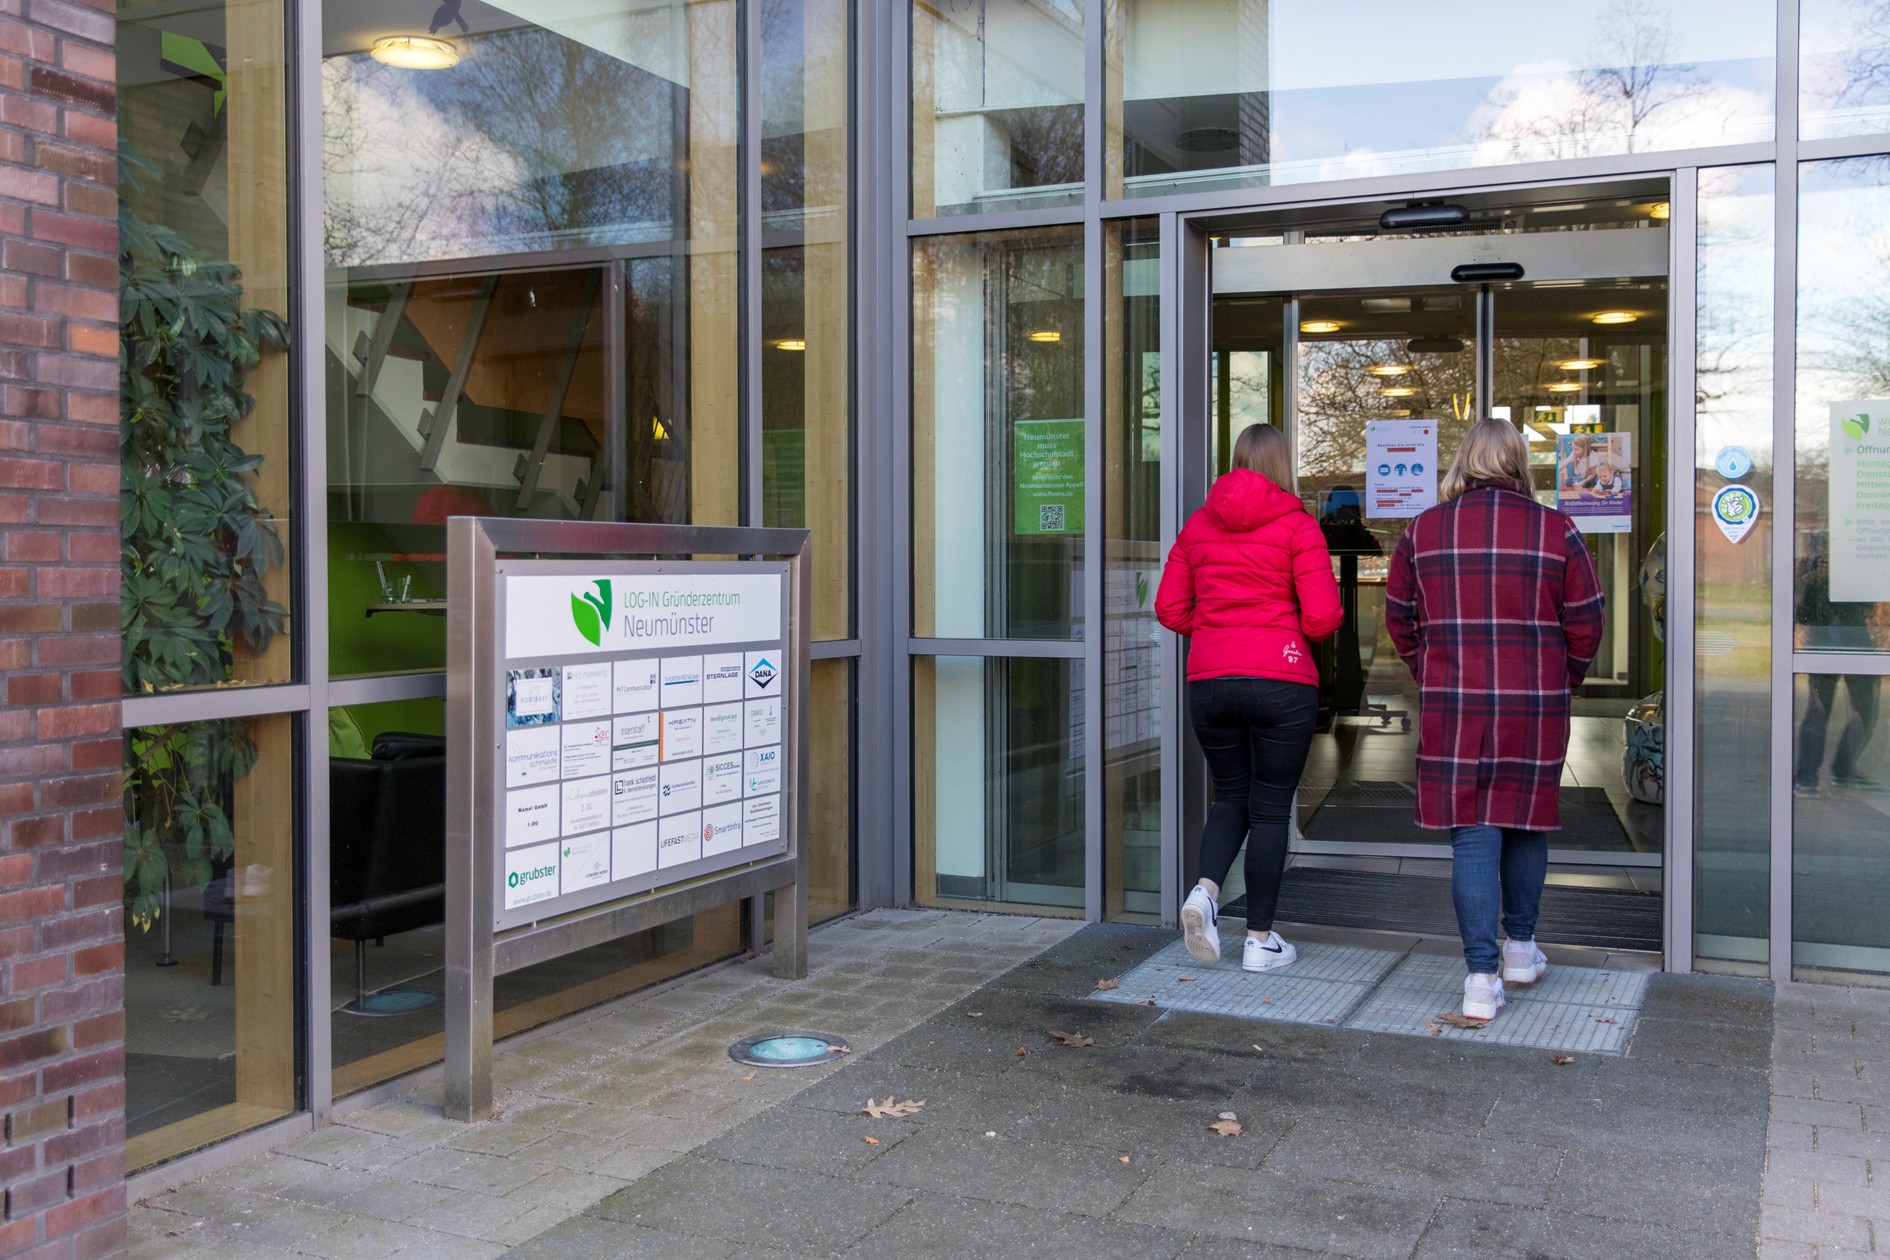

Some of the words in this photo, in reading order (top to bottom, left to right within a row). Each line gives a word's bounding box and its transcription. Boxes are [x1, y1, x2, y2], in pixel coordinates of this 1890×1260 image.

[1024, 433, 1070, 441] Neumünster
[1020, 450, 1074, 459] Hochschulstadt
[1857, 501, 1889, 510] Freitag
[624, 591, 660, 609] LOG-IN
[662, 590, 741, 608] Gründerzentrum
[624, 612, 714, 638] Neumünster
[755, 669, 772, 679] DANA
[521, 695, 549, 704] KONTRAST
[509, 750, 558, 763] kommunikations
[760, 751, 776, 762] XAIO
[529, 758, 558, 768] schmiede
[715, 762, 734, 772] SICCES
[520, 865, 556, 886] grubster
[512, 890, 552, 905] www.grubster.de
